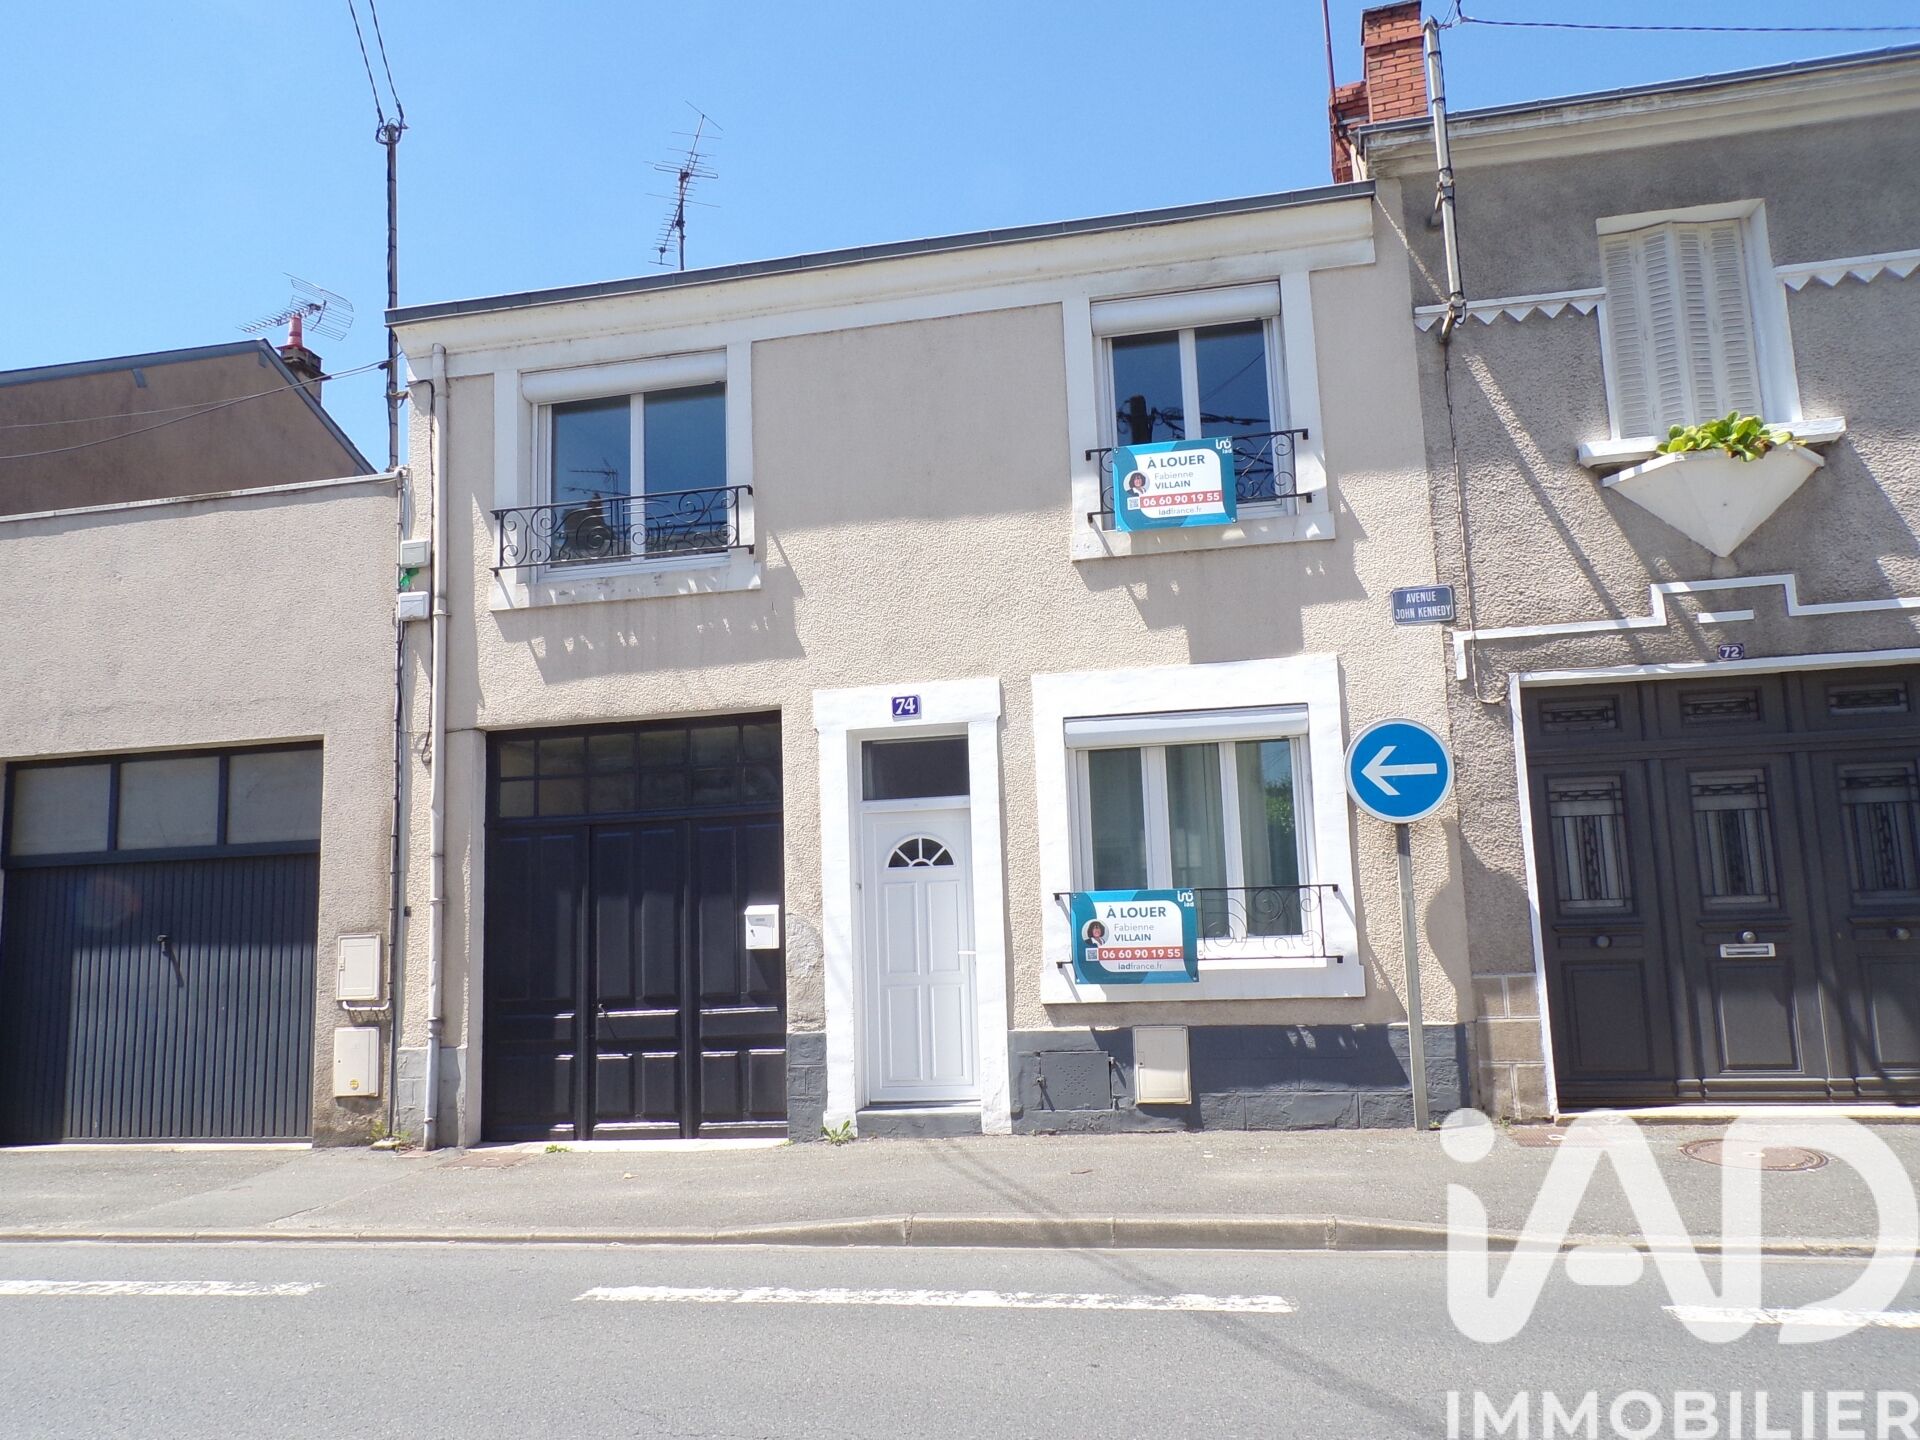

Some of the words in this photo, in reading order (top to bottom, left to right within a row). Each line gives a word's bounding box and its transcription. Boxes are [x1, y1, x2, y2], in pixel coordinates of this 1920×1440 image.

[1148, 457, 1156, 469] À
[1161, 455, 1205, 468] LOUER
[1155, 471, 1194, 480] Fabienne
[1155, 480, 1190, 489] VILLAIN
[1143, 498, 1156, 506] 06
[1159, 497, 1171, 505] 60
[1175, 495, 1187, 503] 90
[1191, 494, 1203, 502] 19
[1207, 492, 1219, 500] 55
[1159, 507, 1203, 515] iadfrance.fr
[1406, 591, 1436, 604] AVENUE
[1396, 608, 1415, 619] JOHN
[1418, 605, 1450, 618] KENNEDY
[1722, 647, 1740, 657] 72
[896, 698, 915, 714] 74
[1107, 905, 1116, 918] À
[1121, 907, 1166, 918] LOUER
[1102, 950, 1115, 958] 06
[1119, 950, 1131, 958] 60
[1135, 950, 1148, 958] 90
[1152, 949, 1164, 957] 19
[1168, 949, 1180, 957] 55
[1118, 961, 1163, 970] iadfrance.fr
